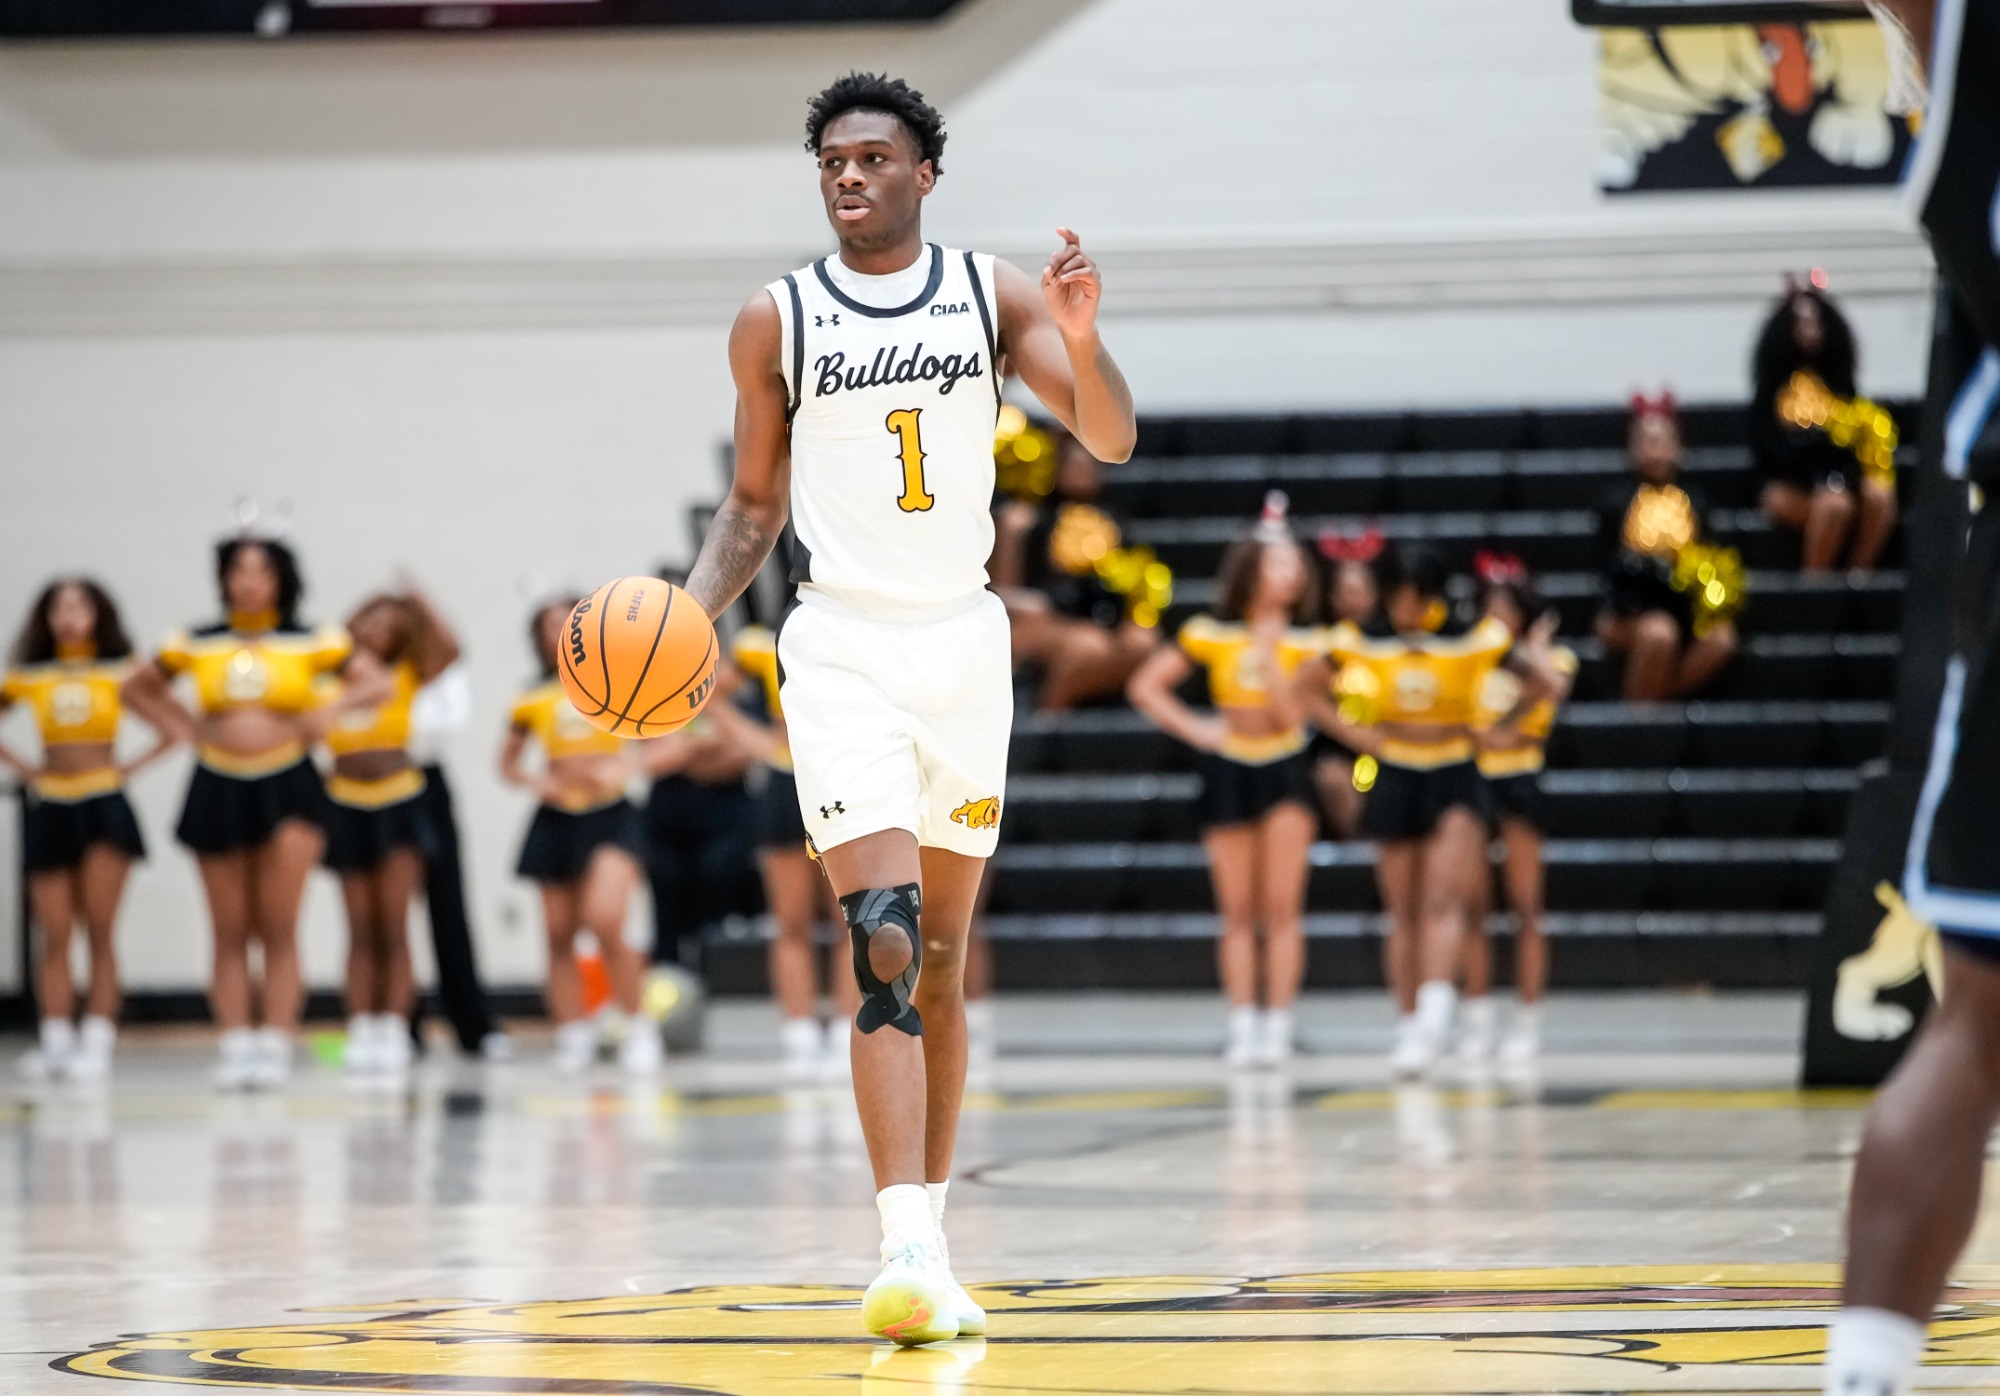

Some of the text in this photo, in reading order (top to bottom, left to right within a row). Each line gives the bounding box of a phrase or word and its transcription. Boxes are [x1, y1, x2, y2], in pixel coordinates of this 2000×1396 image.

[929, 301, 970, 317] CIAA
[814, 342, 983, 397] Bulldogs
[885, 407, 935, 513] 1
